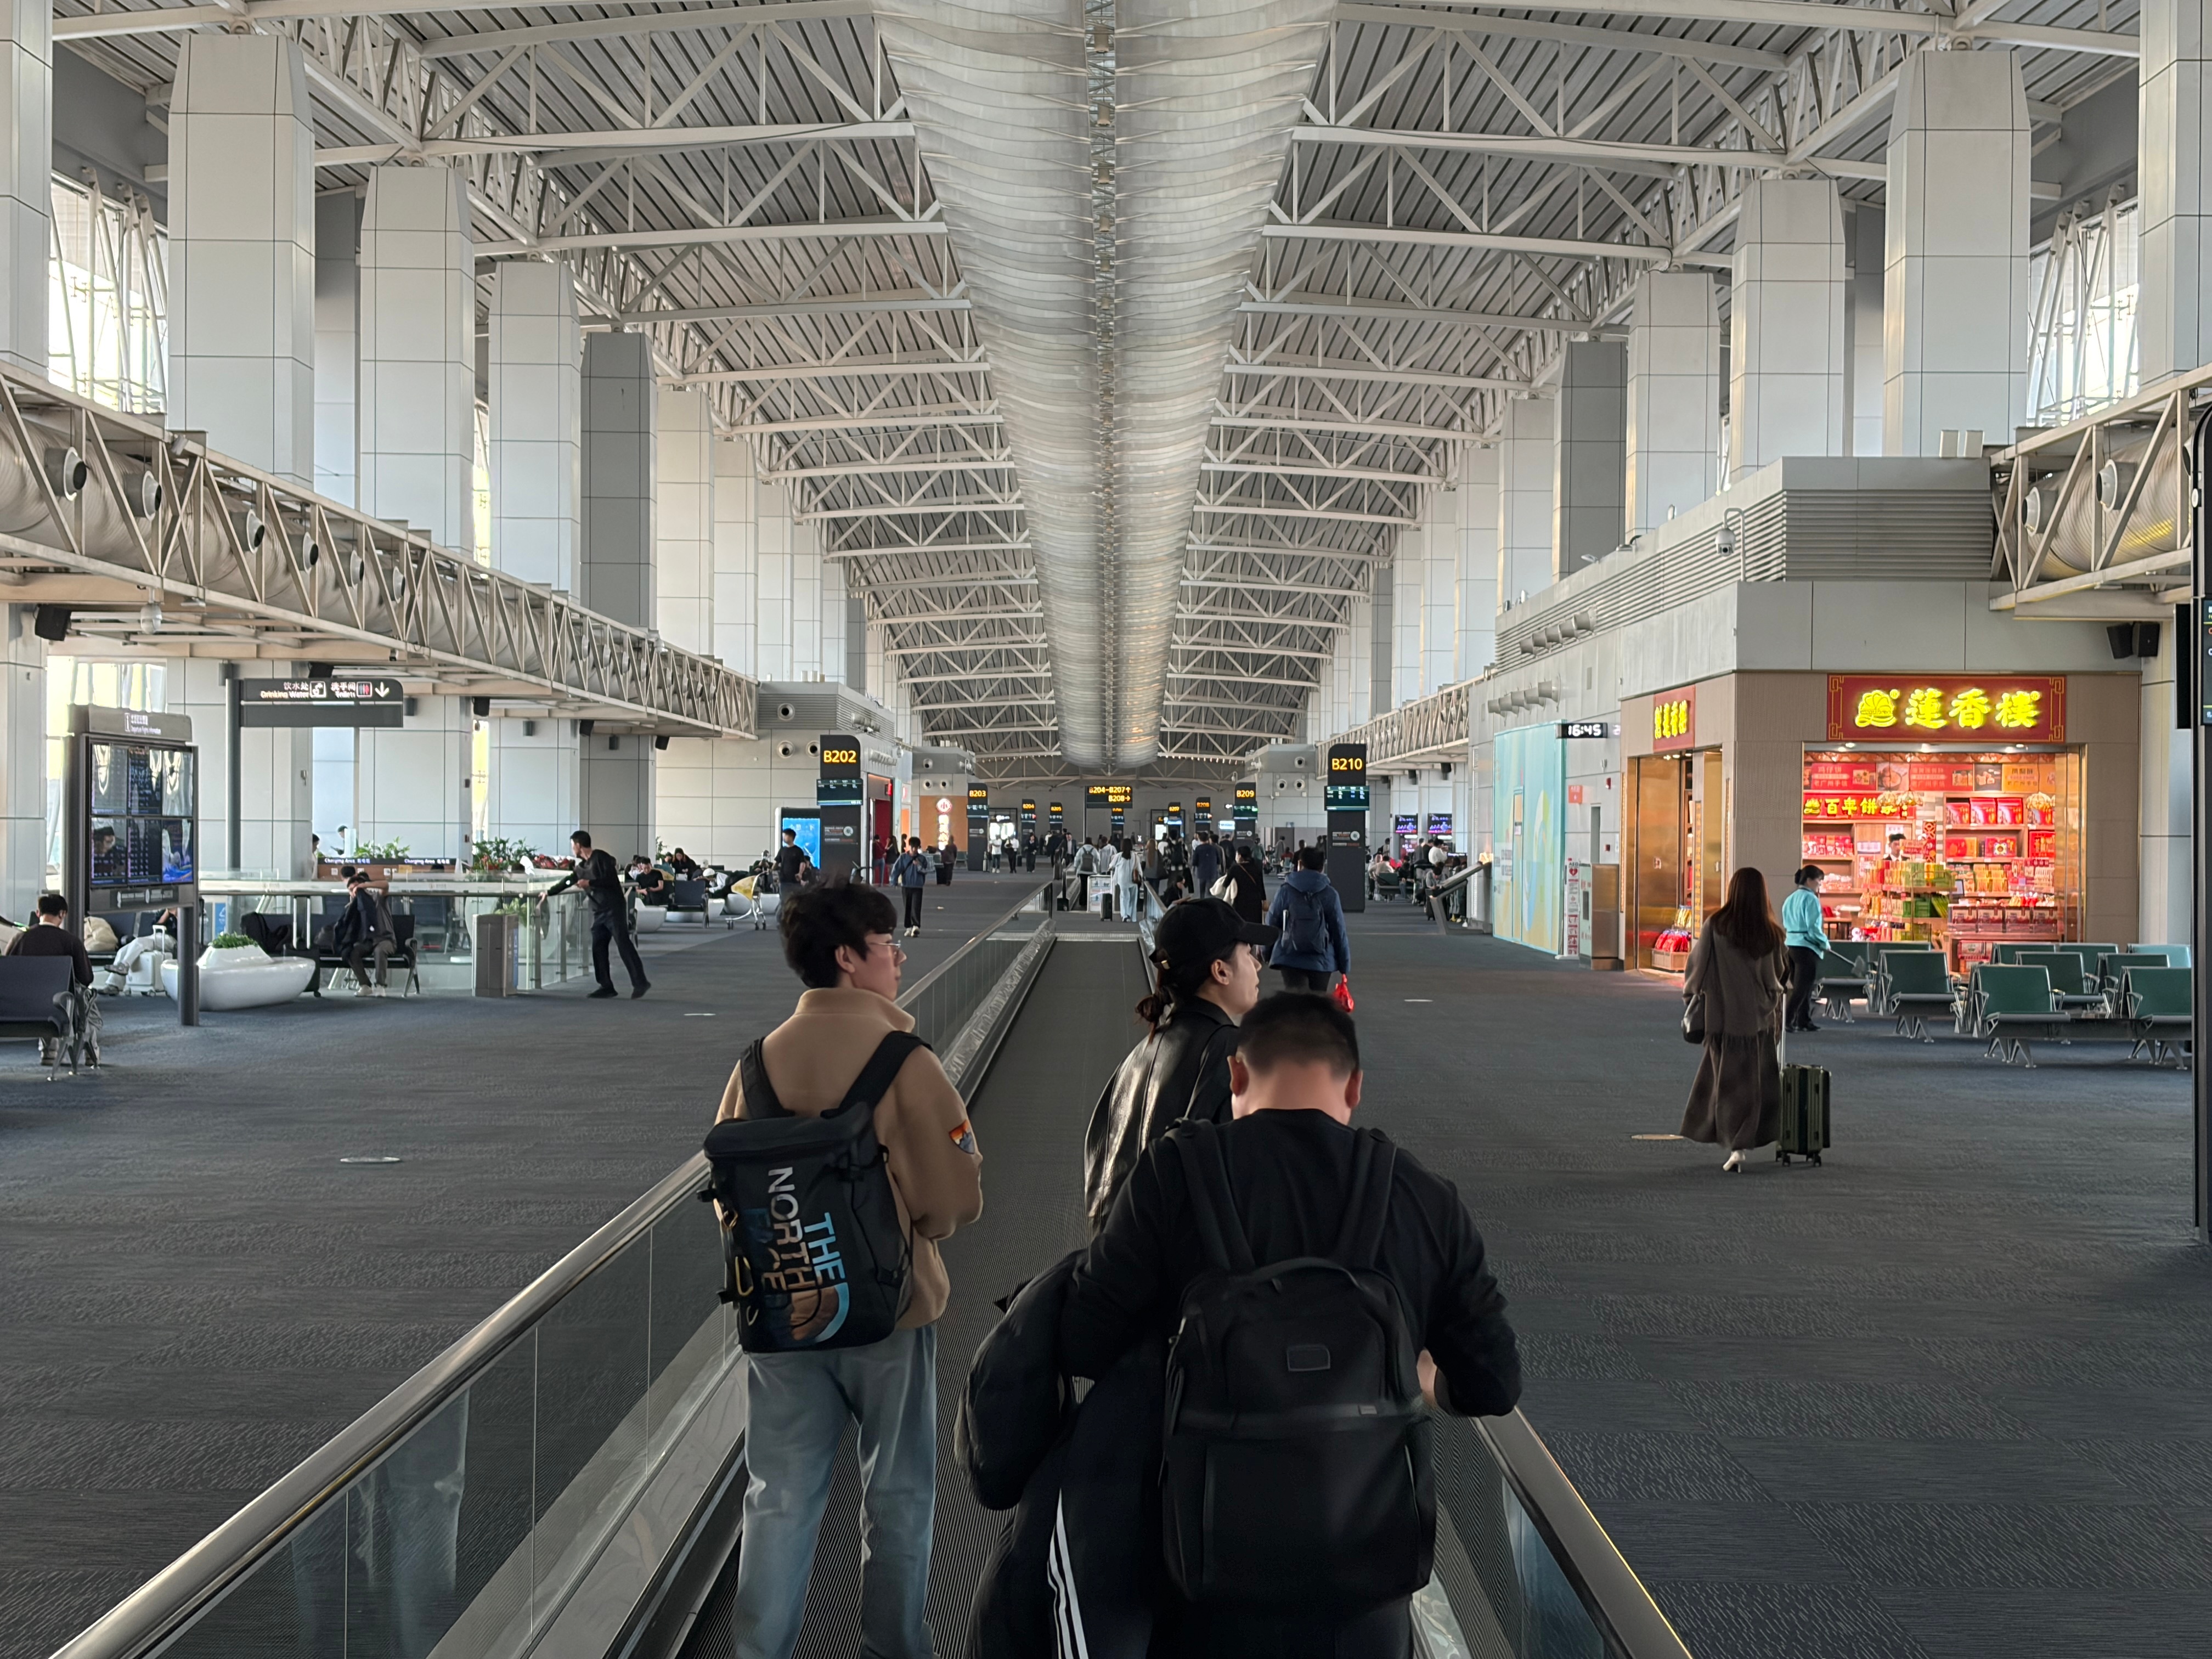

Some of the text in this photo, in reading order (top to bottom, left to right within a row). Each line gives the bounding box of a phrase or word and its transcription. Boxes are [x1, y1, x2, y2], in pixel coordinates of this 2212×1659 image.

[284, 682, 309, 690] 饮水处
[331, 682, 356, 691] 洗手间
[261, 690, 288, 698] Drinking
[1905, 688, 2038, 729] 蓮香樓
[1568, 724, 1601, 736] 16:45
[823, 750, 856, 763] B202
[1332, 758, 1362, 770] B210
[768, 1166, 816, 1289] NORTH
[804, 1212, 845, 1286] THE
